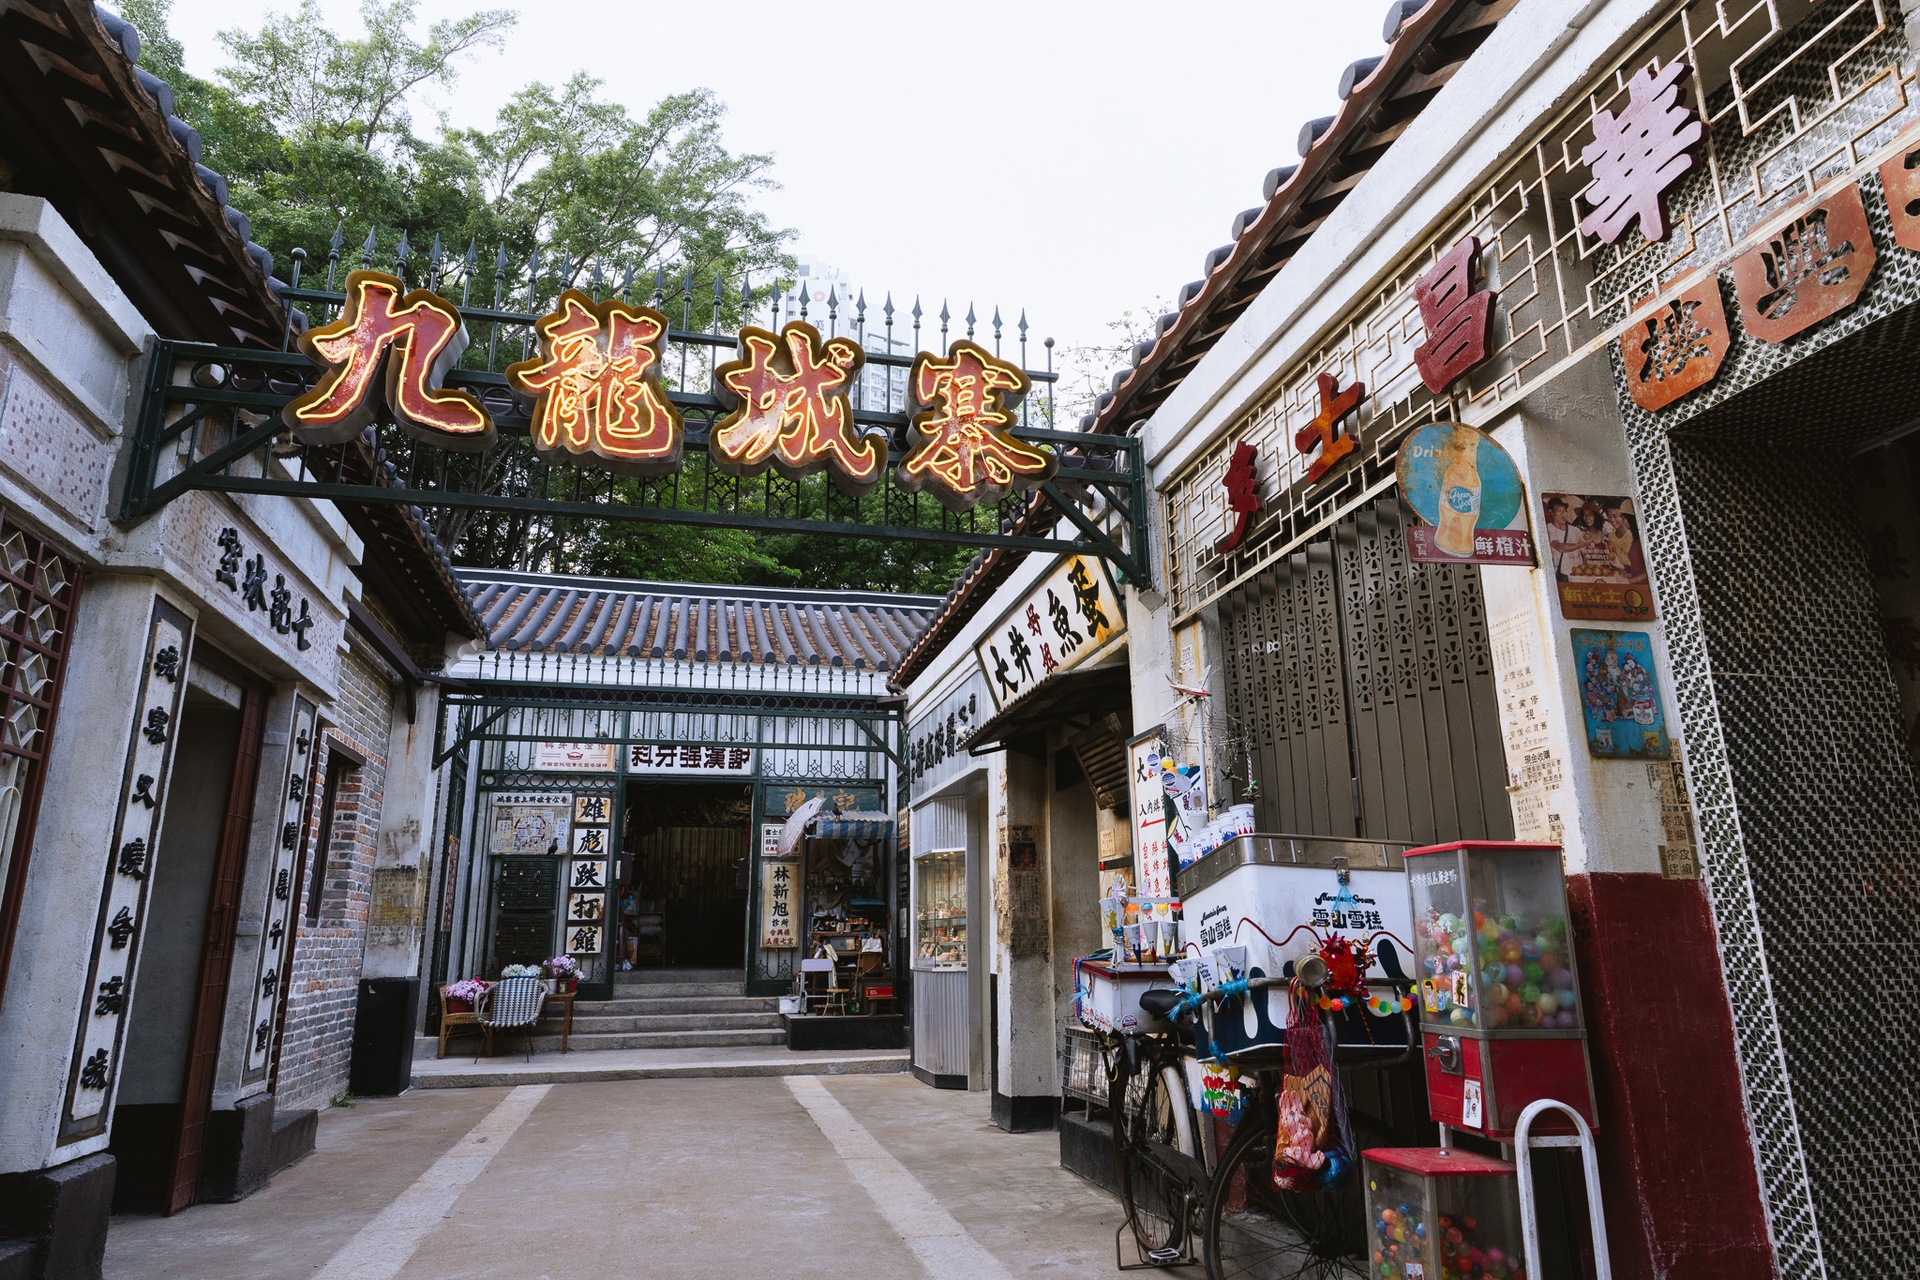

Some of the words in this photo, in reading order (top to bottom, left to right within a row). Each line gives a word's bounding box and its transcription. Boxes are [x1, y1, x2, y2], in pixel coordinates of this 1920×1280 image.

[1640, 148, 1920, 383] 興樓
[284, 270, 1056, 508] 九龍城寨
[1475, 536, 1531, 556] 鮮橙汁
[1563, 587, 1621, 604] 新奇士
[1524, 750, 1551, 765] 現金收購
[784, 788, 861, 814] 瑞記
[571, 798, 606, 953] 雄彪跌打館
[1200, 916, 1232, 947] 雪山雪糕
[1312, 908, 1384, 930] 雪山雪糕
